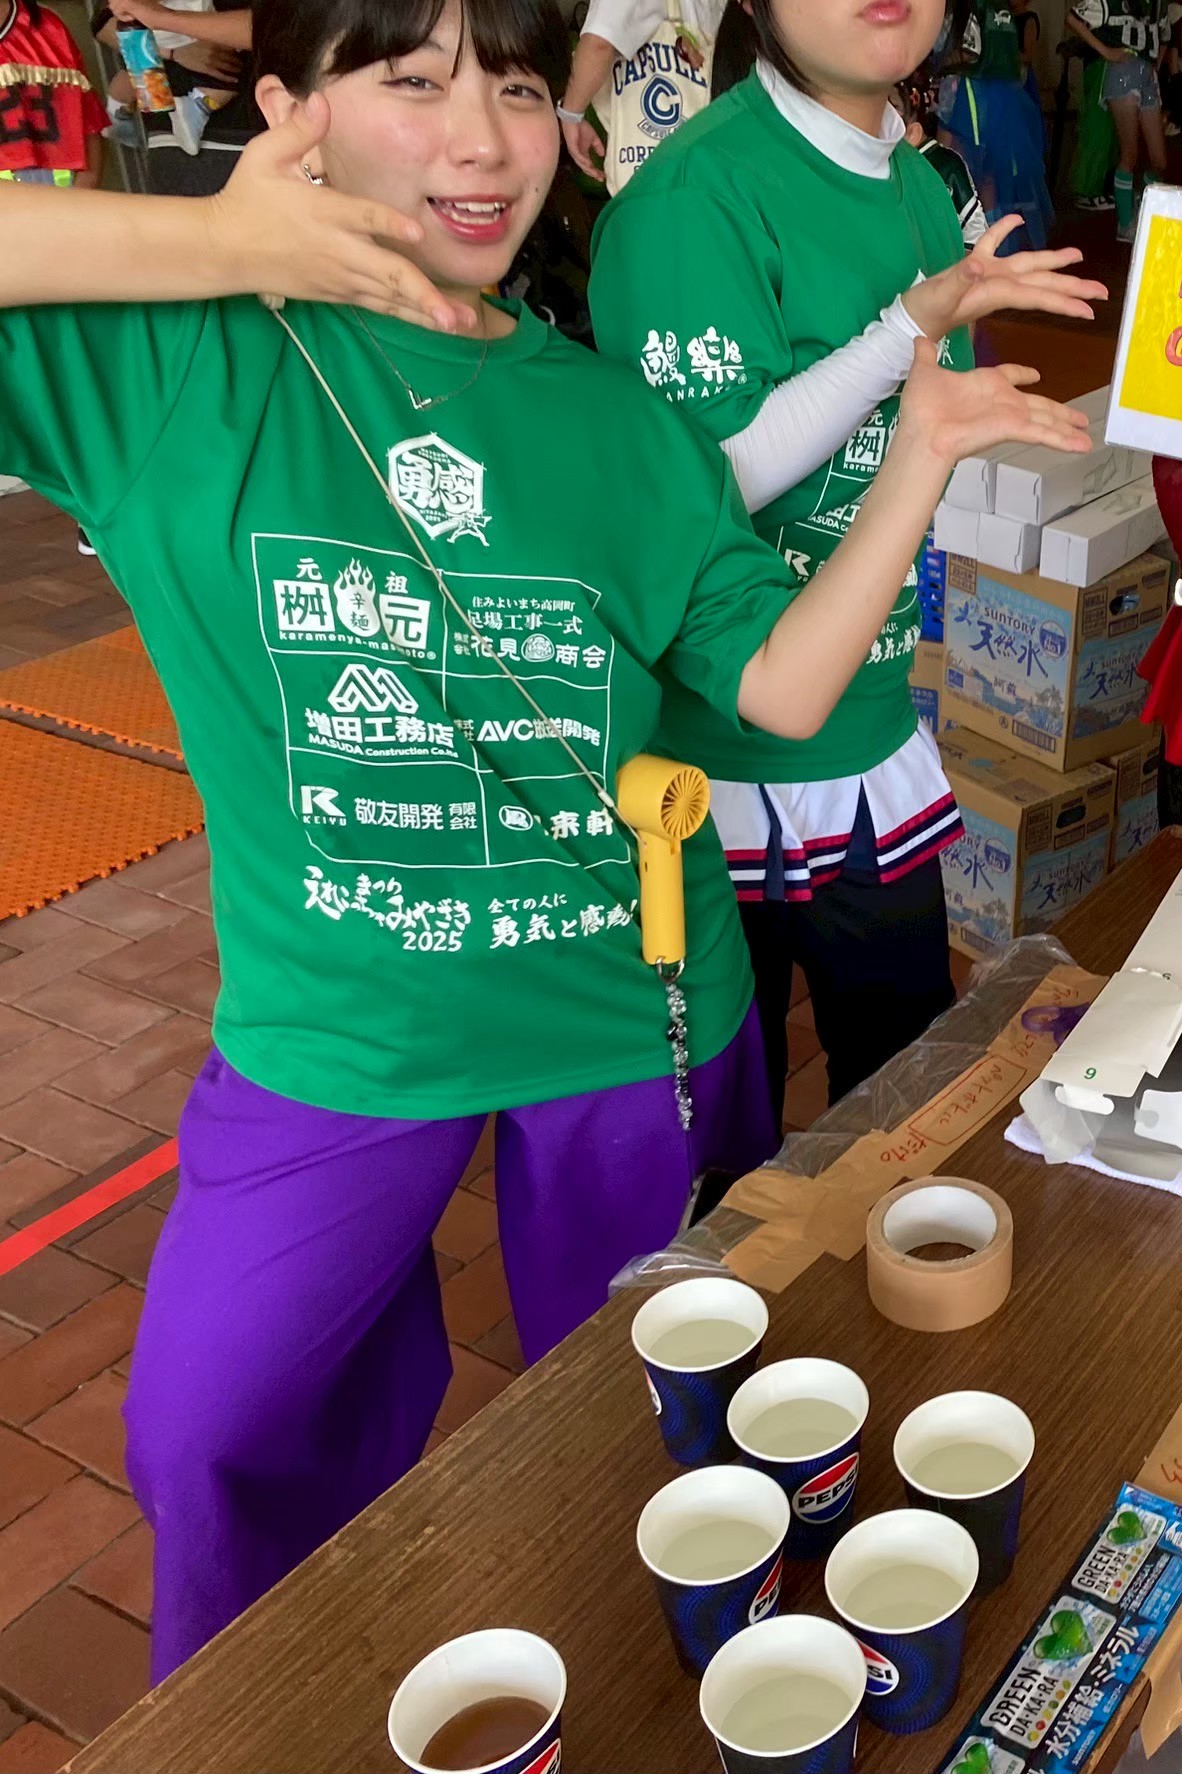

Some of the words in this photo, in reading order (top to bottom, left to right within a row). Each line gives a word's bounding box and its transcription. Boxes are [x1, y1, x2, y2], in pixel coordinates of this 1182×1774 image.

[984, 607, 1036, 636] SUNTORY
[555, 643, 607, 669] 商会
[968, 616, 1049, 679] 天然水
[304, 707, 455, 749] 増田工務店
[308, 732, 364, 756] MASUDA
[365, 747, 429, 758] Construction
[302, 815, 347, 827] KEIYU
[354, 797, 445, 831] 敬友開発
[487, 893, 568, 914] 全ての人に
[402, 930, 463, 952] 2025
[1076, 1544, 1118, 1589] GREEN
[988, 1665, 1043, 1727] GREEN
